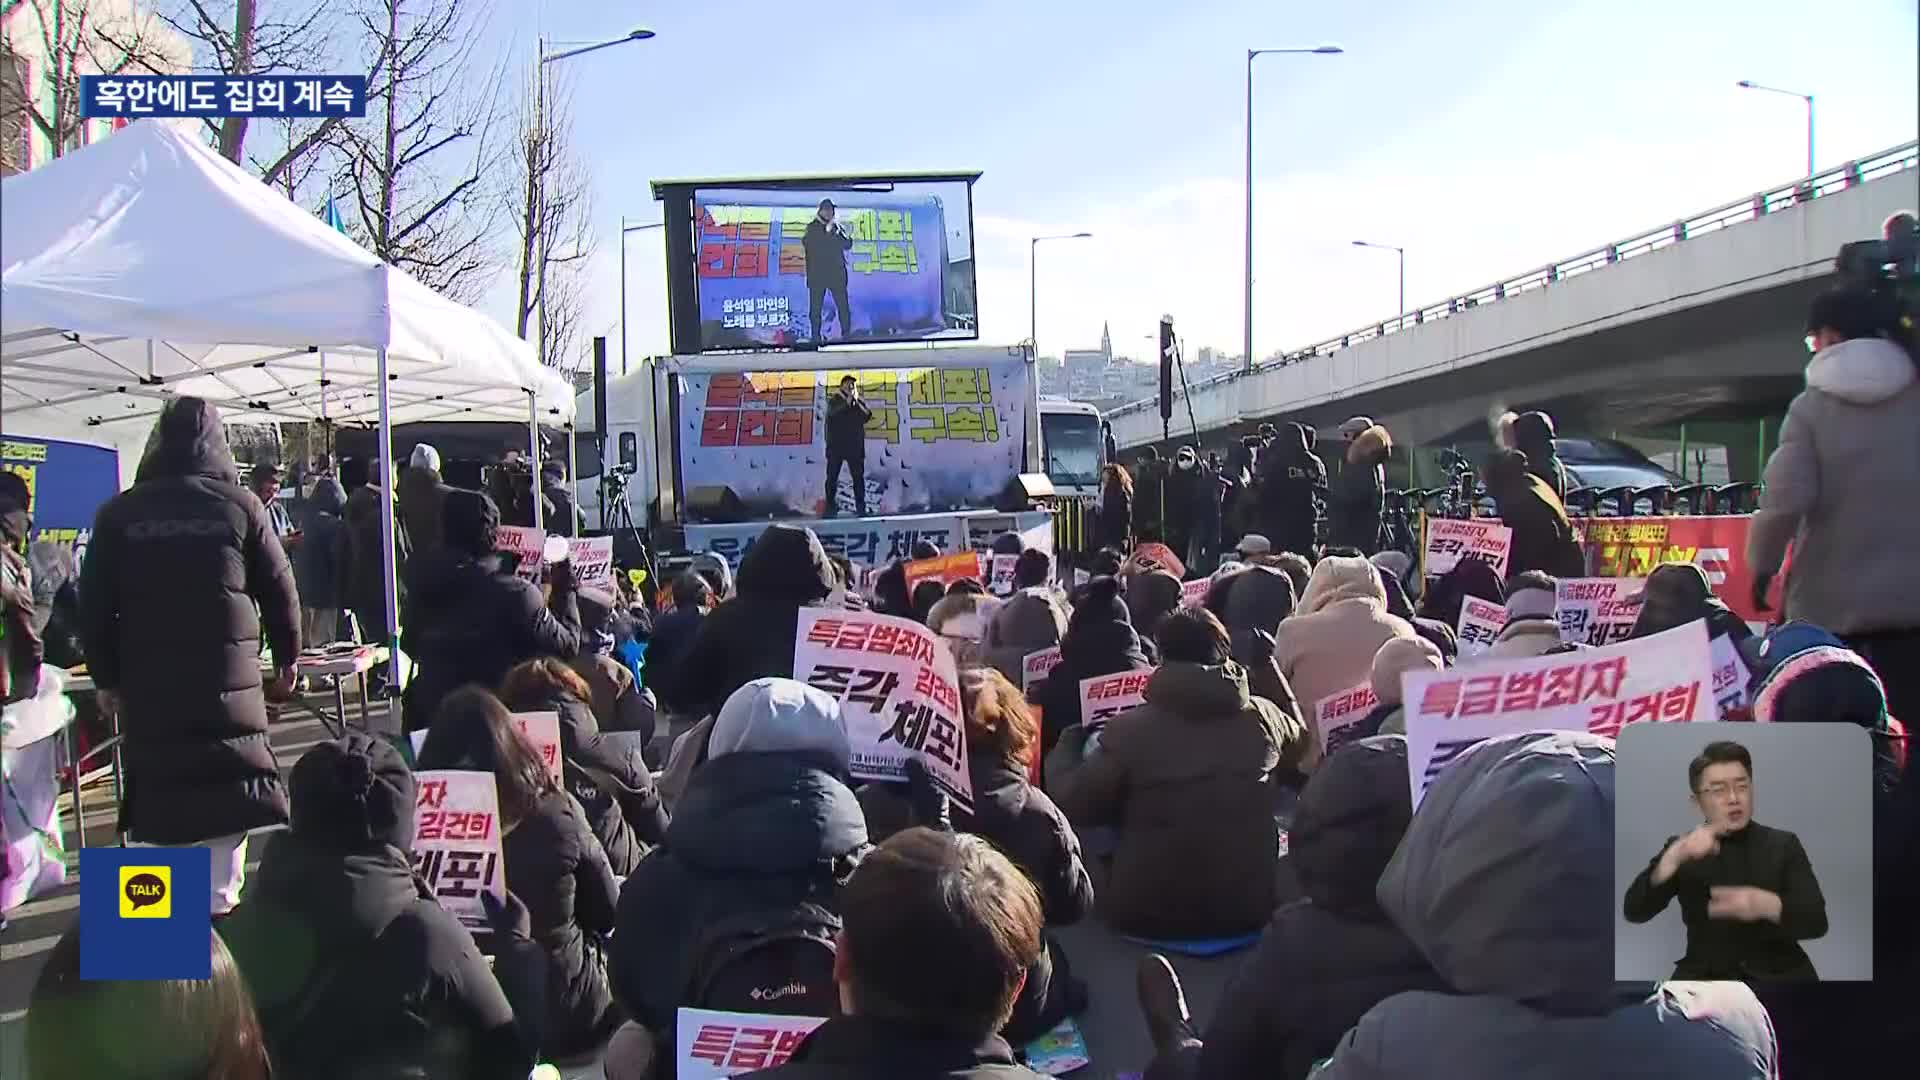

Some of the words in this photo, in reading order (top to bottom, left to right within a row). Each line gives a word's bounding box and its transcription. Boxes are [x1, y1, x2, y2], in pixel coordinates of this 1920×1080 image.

[722, 297, 755, 313] 윤석열
[723, 313, 755, 329] 노래를
[757, 312, 789, 327] 부르자
[907, 366, 993, 405] 체포!
[909, 405, 1001, 444] 구속!
[806, 618, 936, 667] 특급범죄자
[914, 666, 959, 716] 김건희
[1420, 655, 1629, 719] 특급범죄자
[877, 700, 964, 772] 체포!
[416, 812, 493, 841] 김건희
